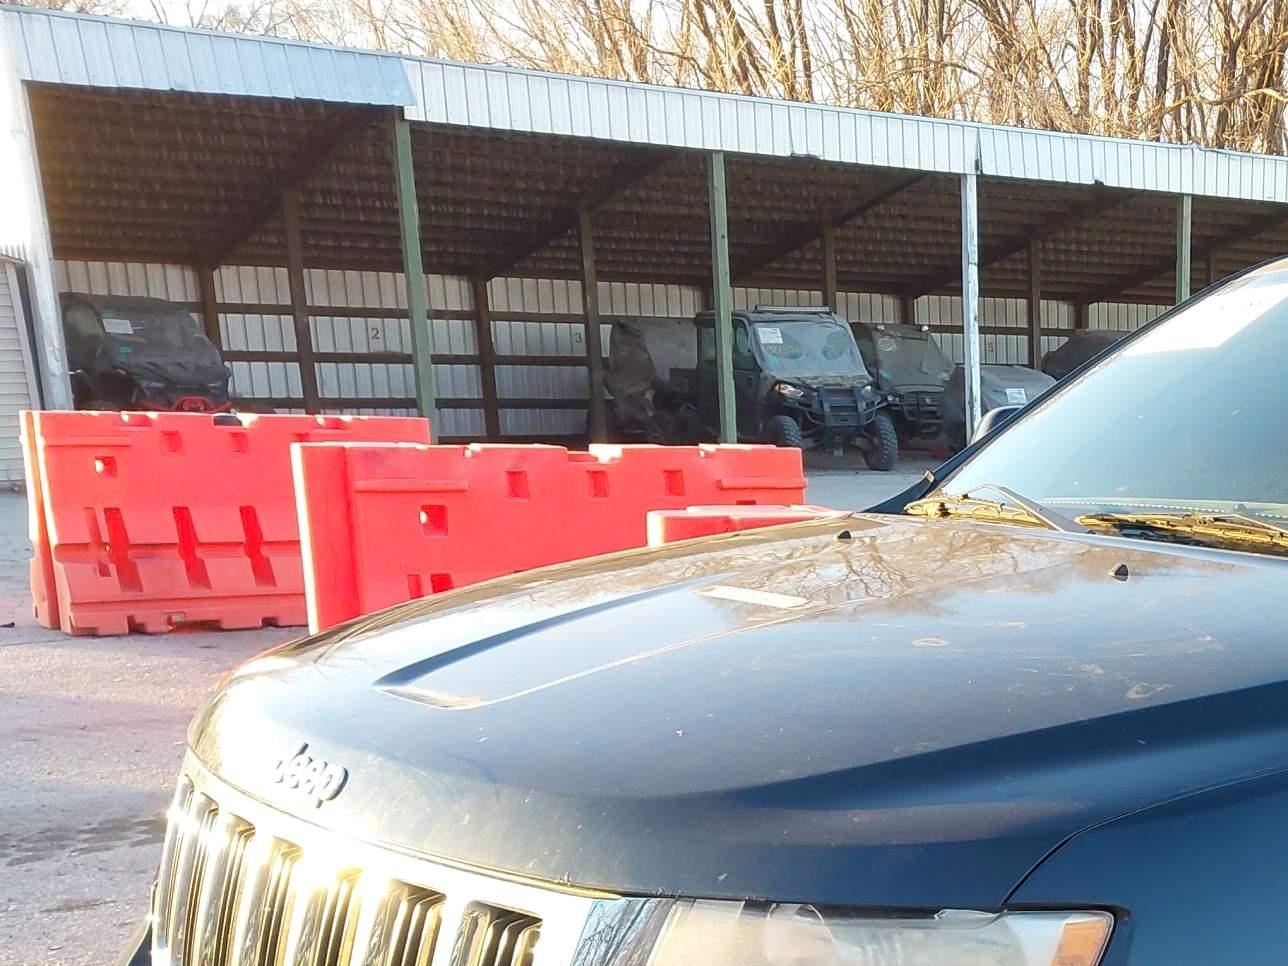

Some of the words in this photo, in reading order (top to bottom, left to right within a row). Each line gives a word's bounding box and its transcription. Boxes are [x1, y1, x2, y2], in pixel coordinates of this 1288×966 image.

[371, 327, 380, 340] 2
[574, 332, 583, 344] 3
[273, 743, 349, 808] Jeep
